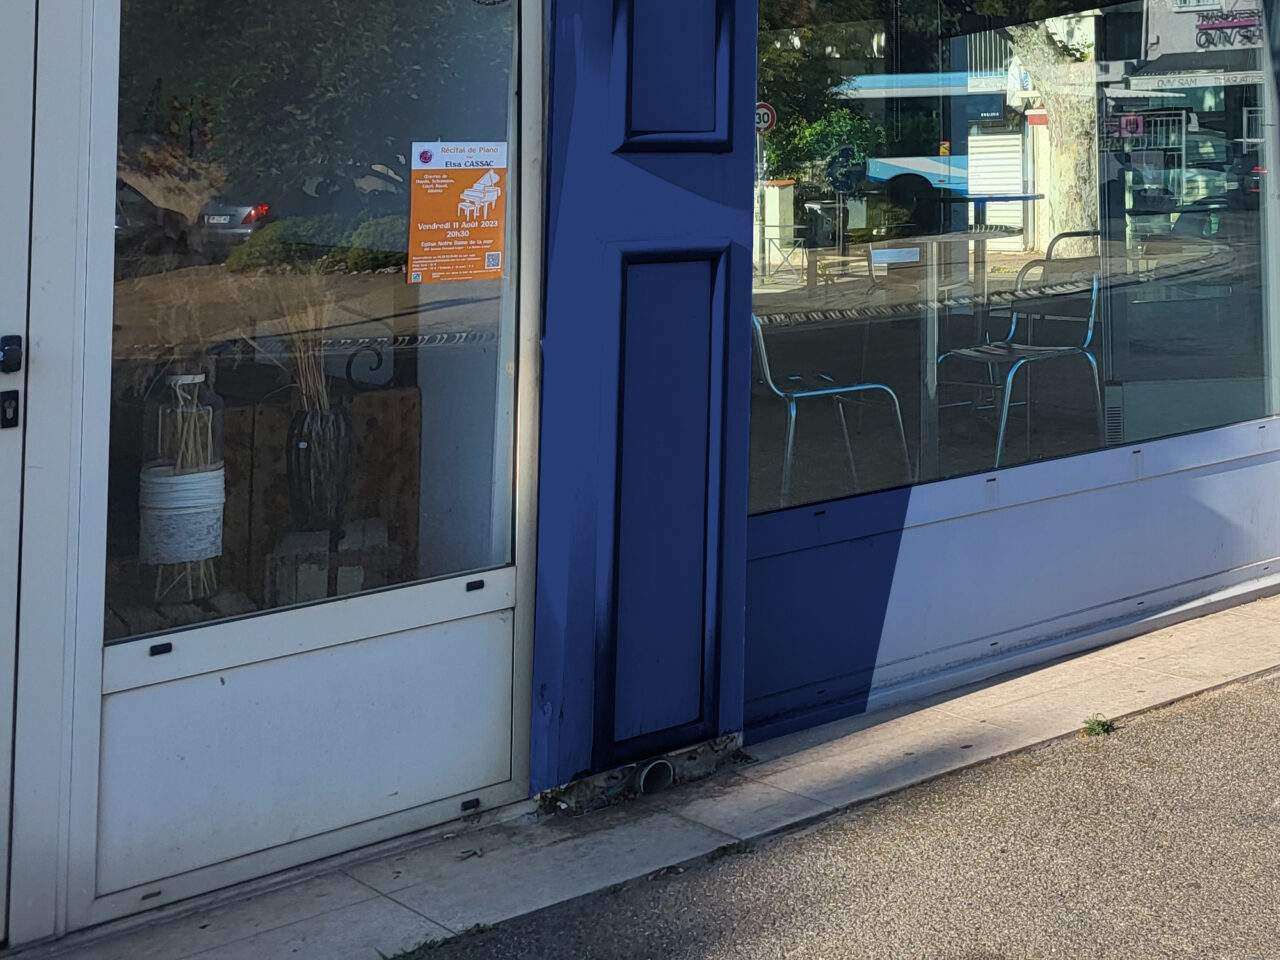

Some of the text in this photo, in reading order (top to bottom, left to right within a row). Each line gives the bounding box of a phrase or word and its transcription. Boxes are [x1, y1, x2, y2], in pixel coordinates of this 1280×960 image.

[755, 112, 769, 125] 30
[441, 146, 466, 154] Récital
[445, 160, 495, 168] Elsa CASSAC
[418, 222, 451, 230] Vendredi
[480, 220, 498, 228] 2023
[446, 230, 469, 238] 20h30
